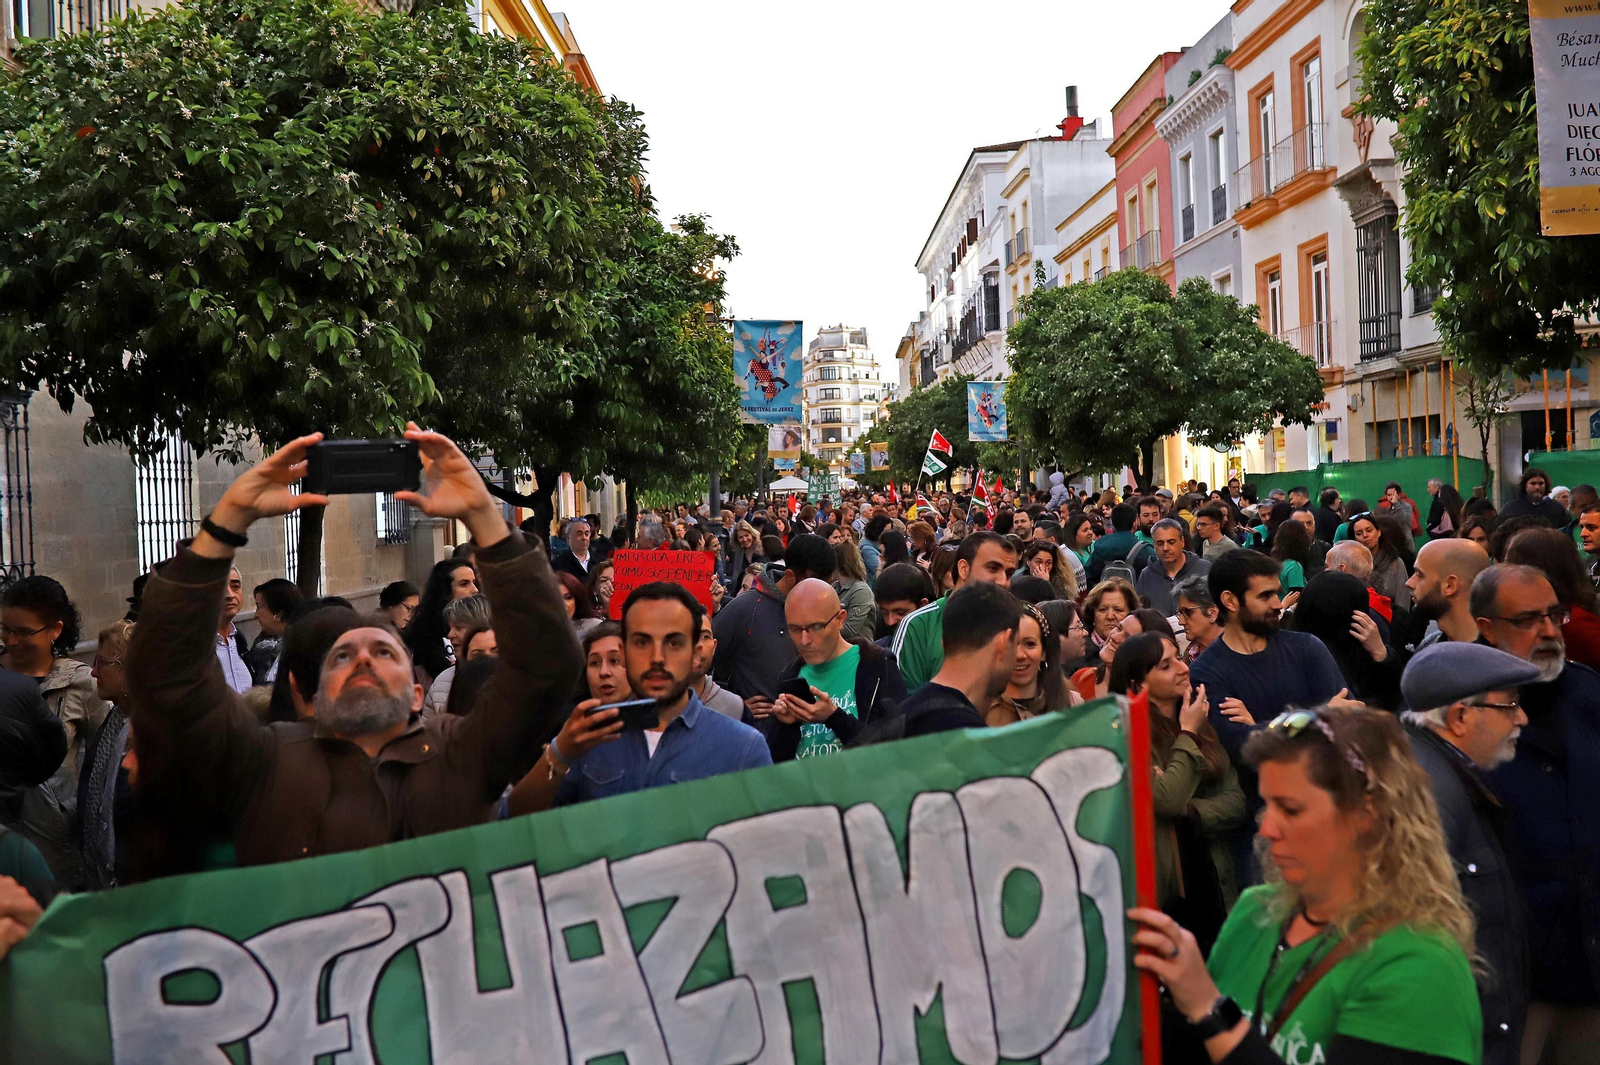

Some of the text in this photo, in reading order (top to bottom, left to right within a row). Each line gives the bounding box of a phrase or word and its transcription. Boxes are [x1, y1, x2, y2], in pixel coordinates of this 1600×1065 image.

[1567, 102, 1600, 118] JUA
[1569, 167, 1576, 177] 3
[810, 476, 821, 485] NO
[616, 551, 708, 565] IMBRODA, ERES
[614, 566, 713, 582] COMO SUSPENDER
[103, 746, 1125, 1065] RECHAZAMOS
